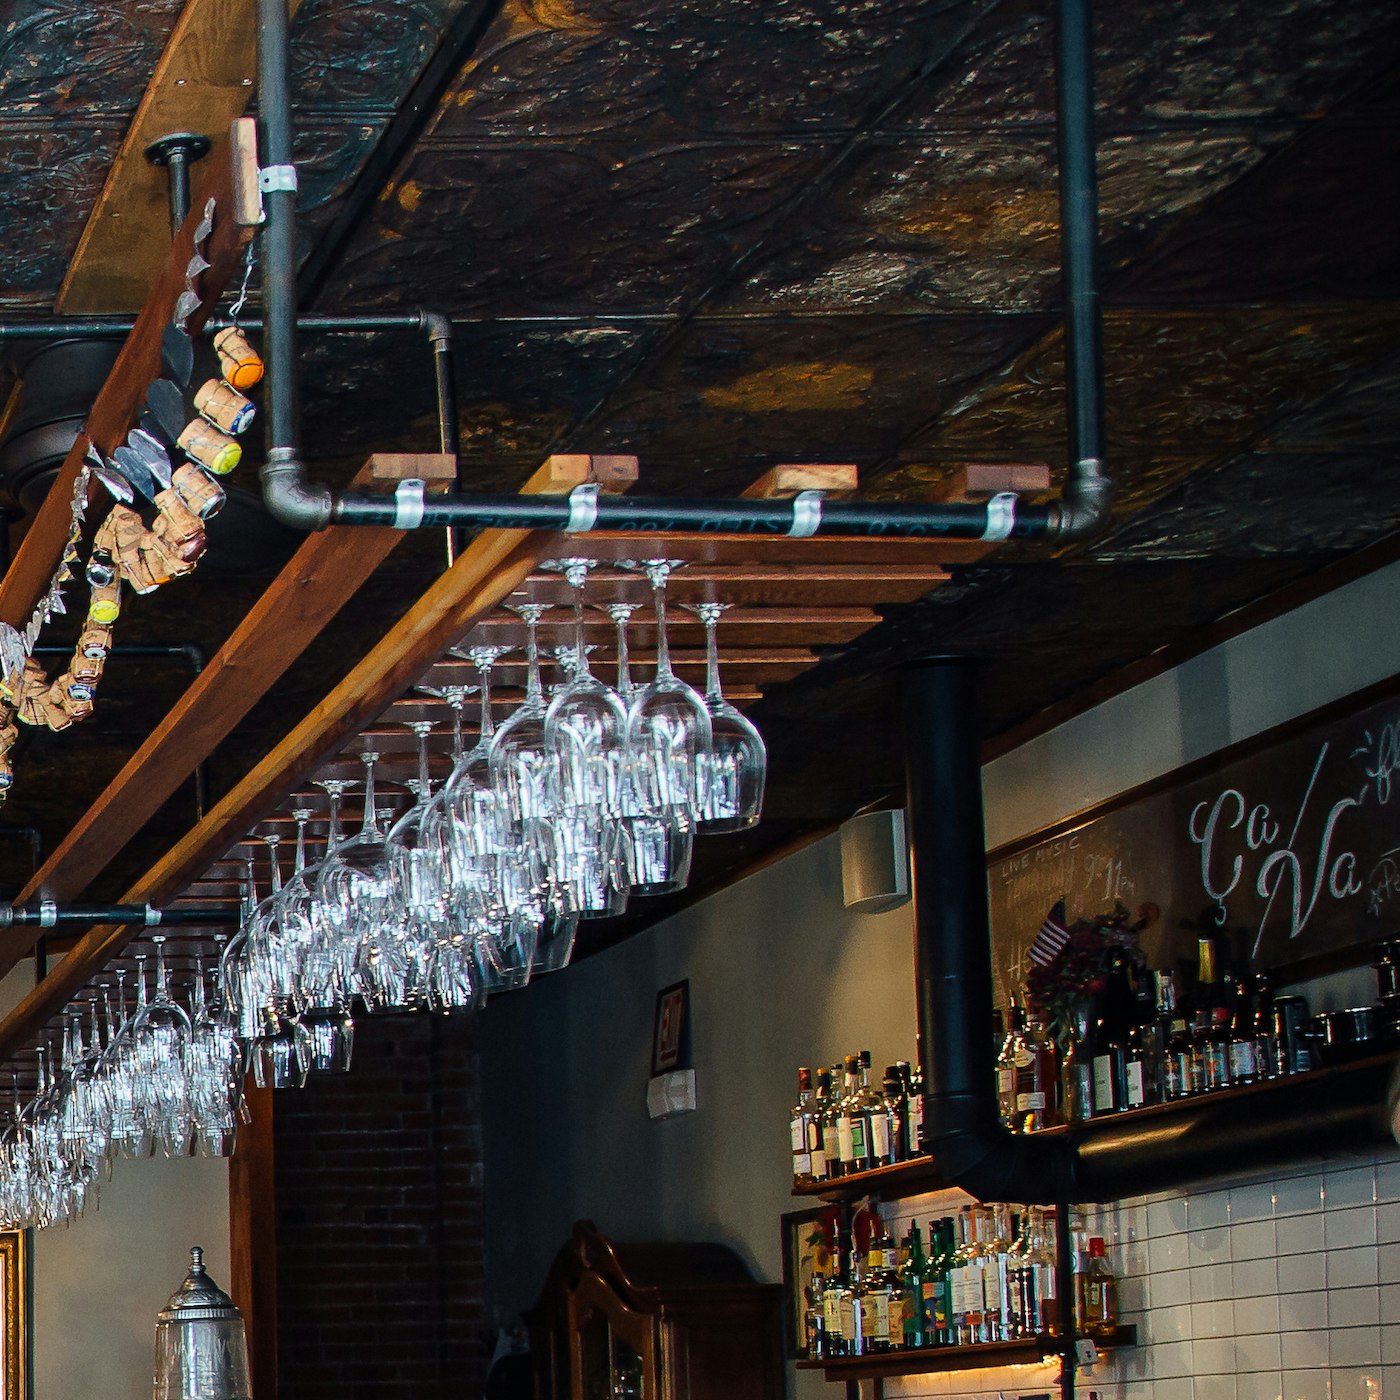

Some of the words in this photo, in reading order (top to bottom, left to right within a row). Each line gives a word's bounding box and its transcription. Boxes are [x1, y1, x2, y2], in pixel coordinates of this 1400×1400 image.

[1001, 853, 1031, 878] LIVE
[1034, 836, 1082, 863] MUSIC
[1187, 788, 1280, 927] Ça
[1255, 796, 1363, 940] Va
